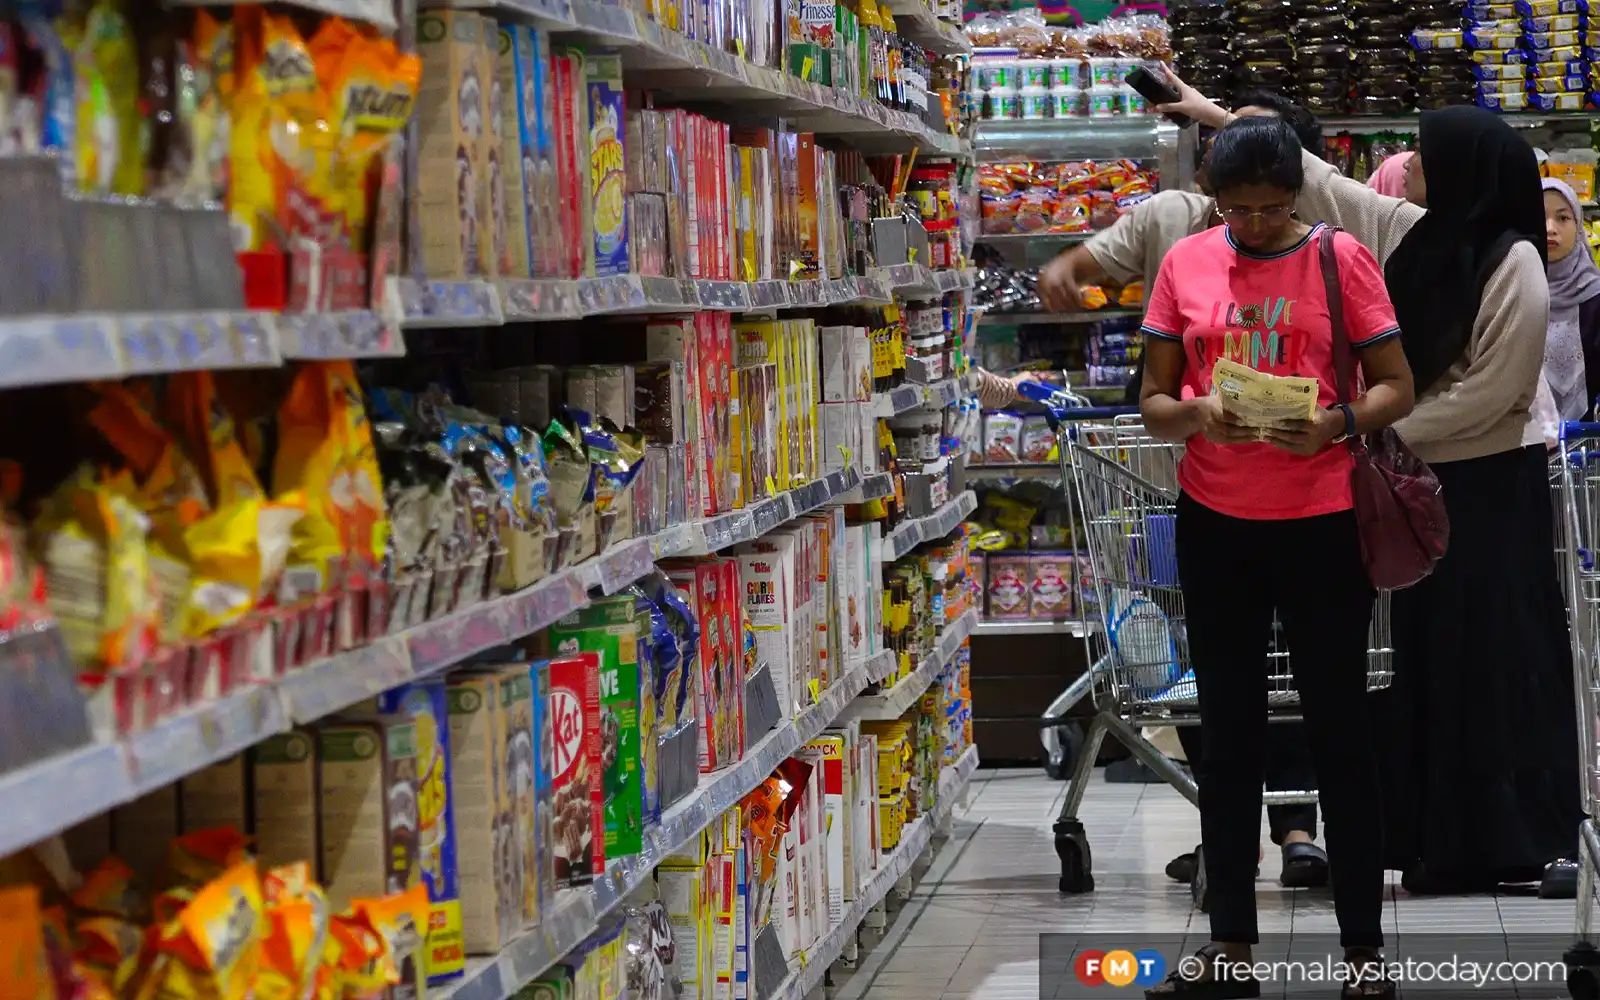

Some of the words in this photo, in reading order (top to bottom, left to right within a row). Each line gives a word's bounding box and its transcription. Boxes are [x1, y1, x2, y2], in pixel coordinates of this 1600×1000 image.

[1210, 301, 1221, 328] I
[1225, 296, 1297, 329] LOVE
[1194, 330, 1311, 370] SUMMER
[747, 581, 774, 595] CORN
[747, 594, 775, 605] FLAKES
[551, 694, 580, 775] Kat
